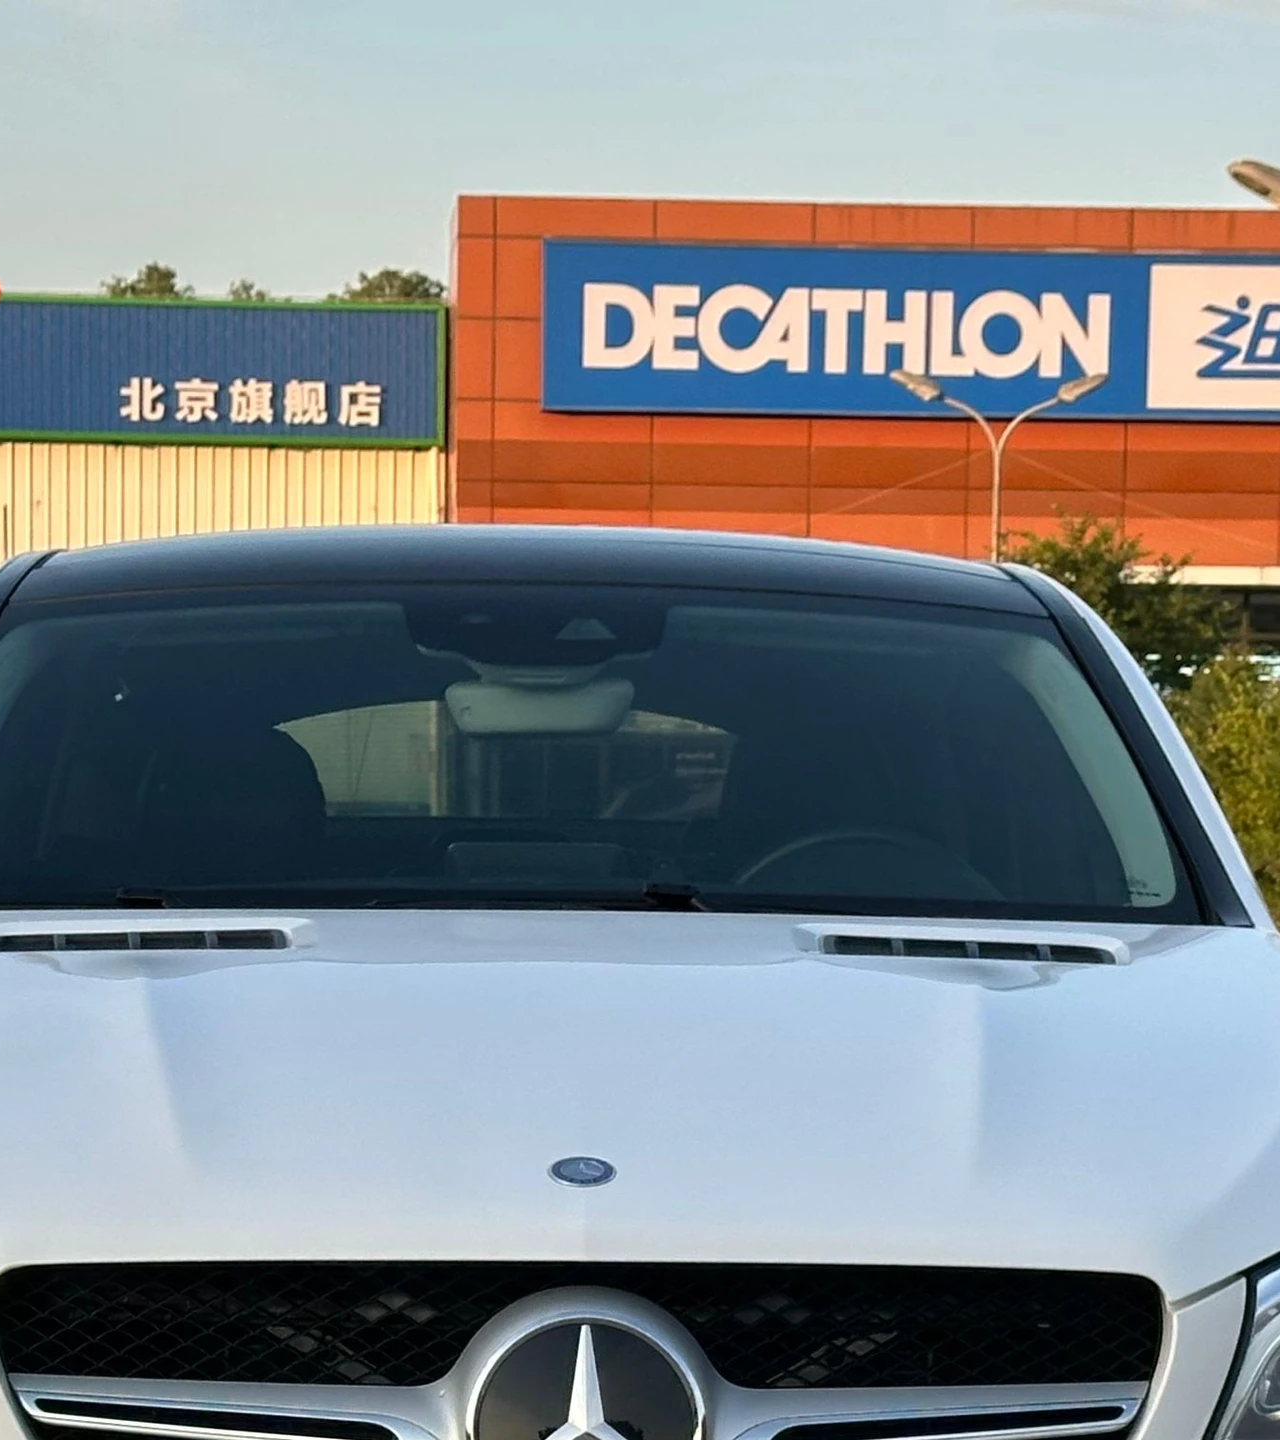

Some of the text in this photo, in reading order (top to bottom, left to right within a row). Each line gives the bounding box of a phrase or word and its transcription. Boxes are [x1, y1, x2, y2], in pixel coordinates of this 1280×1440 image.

[582, 282, 1111, 378] DECATHLON
[119, 377, 382, 427] 北京旗舰店
